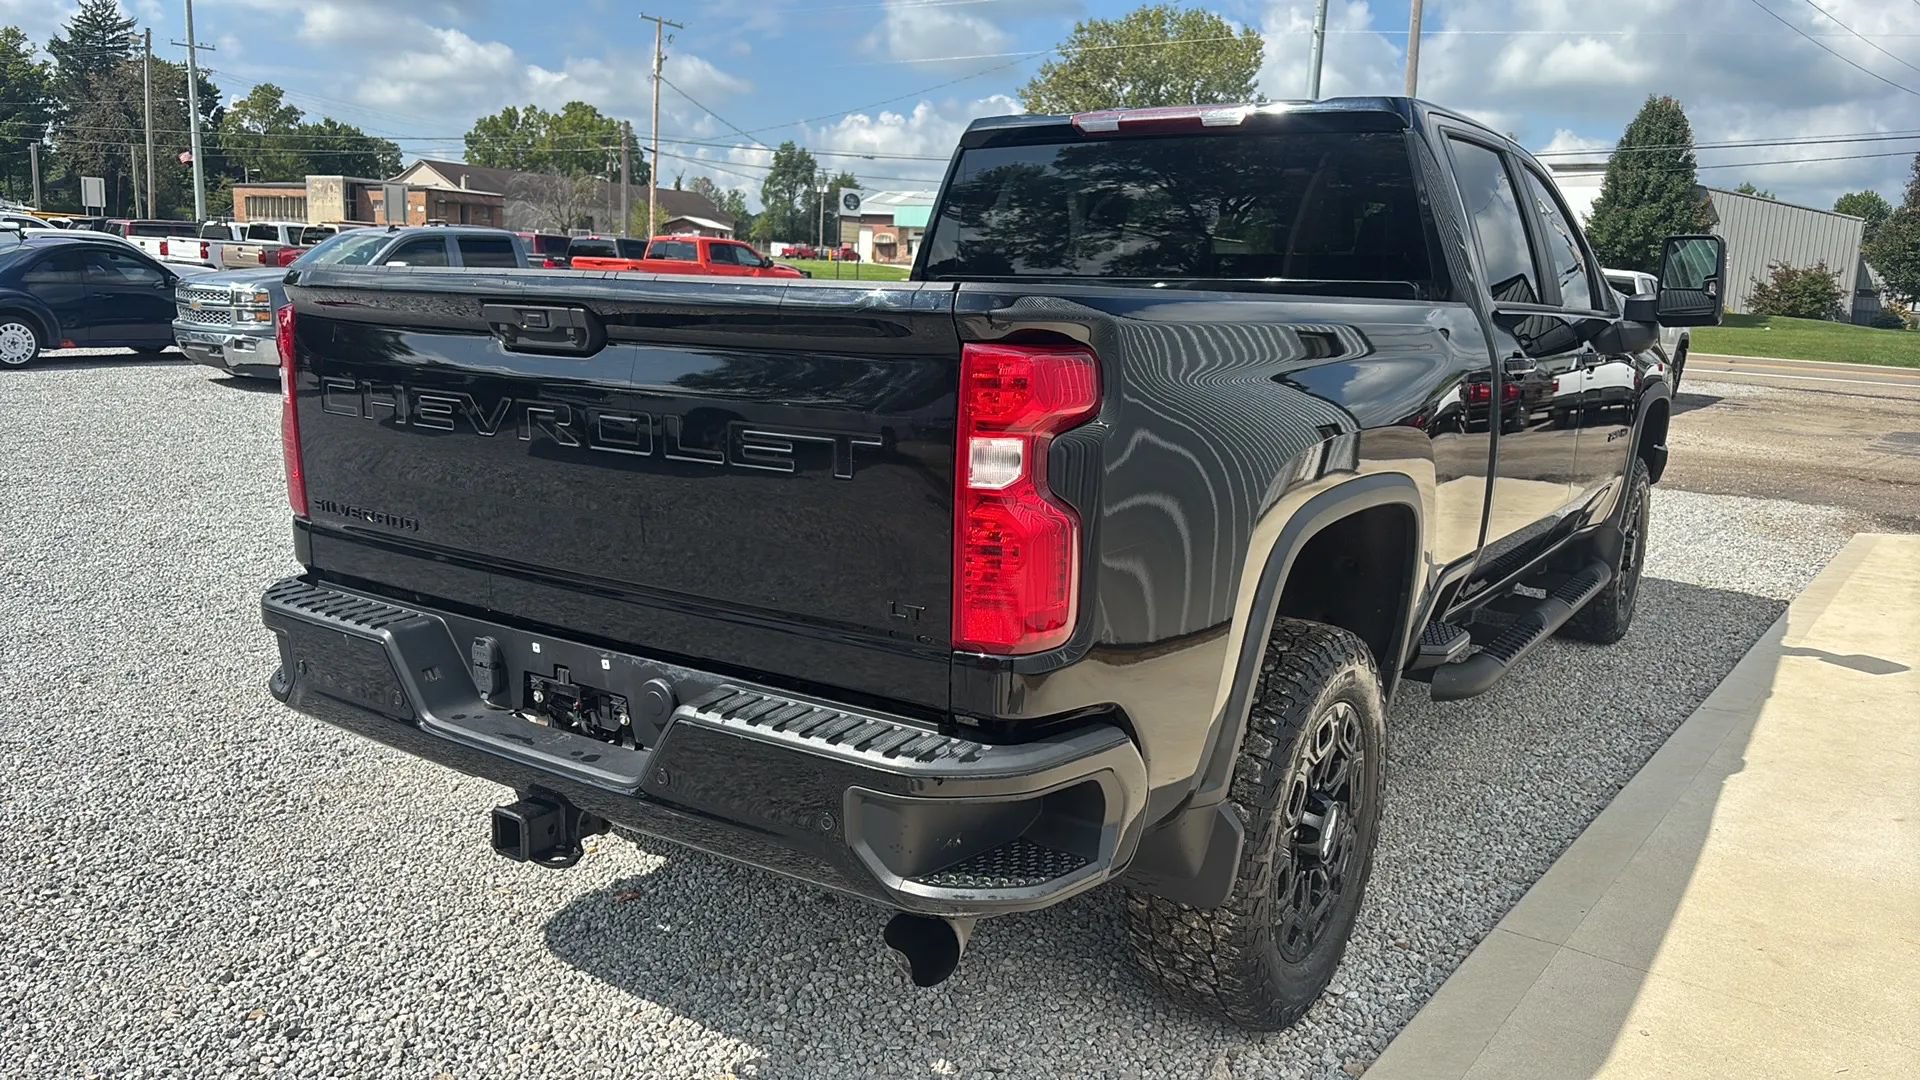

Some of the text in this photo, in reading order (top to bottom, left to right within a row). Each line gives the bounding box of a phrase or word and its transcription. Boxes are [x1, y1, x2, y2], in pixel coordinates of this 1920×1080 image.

[320, 375, 883, 479] CHEVROLET
[314, 498, 419, 532] SILVERADO
[887, 600, 926, 620] LT
